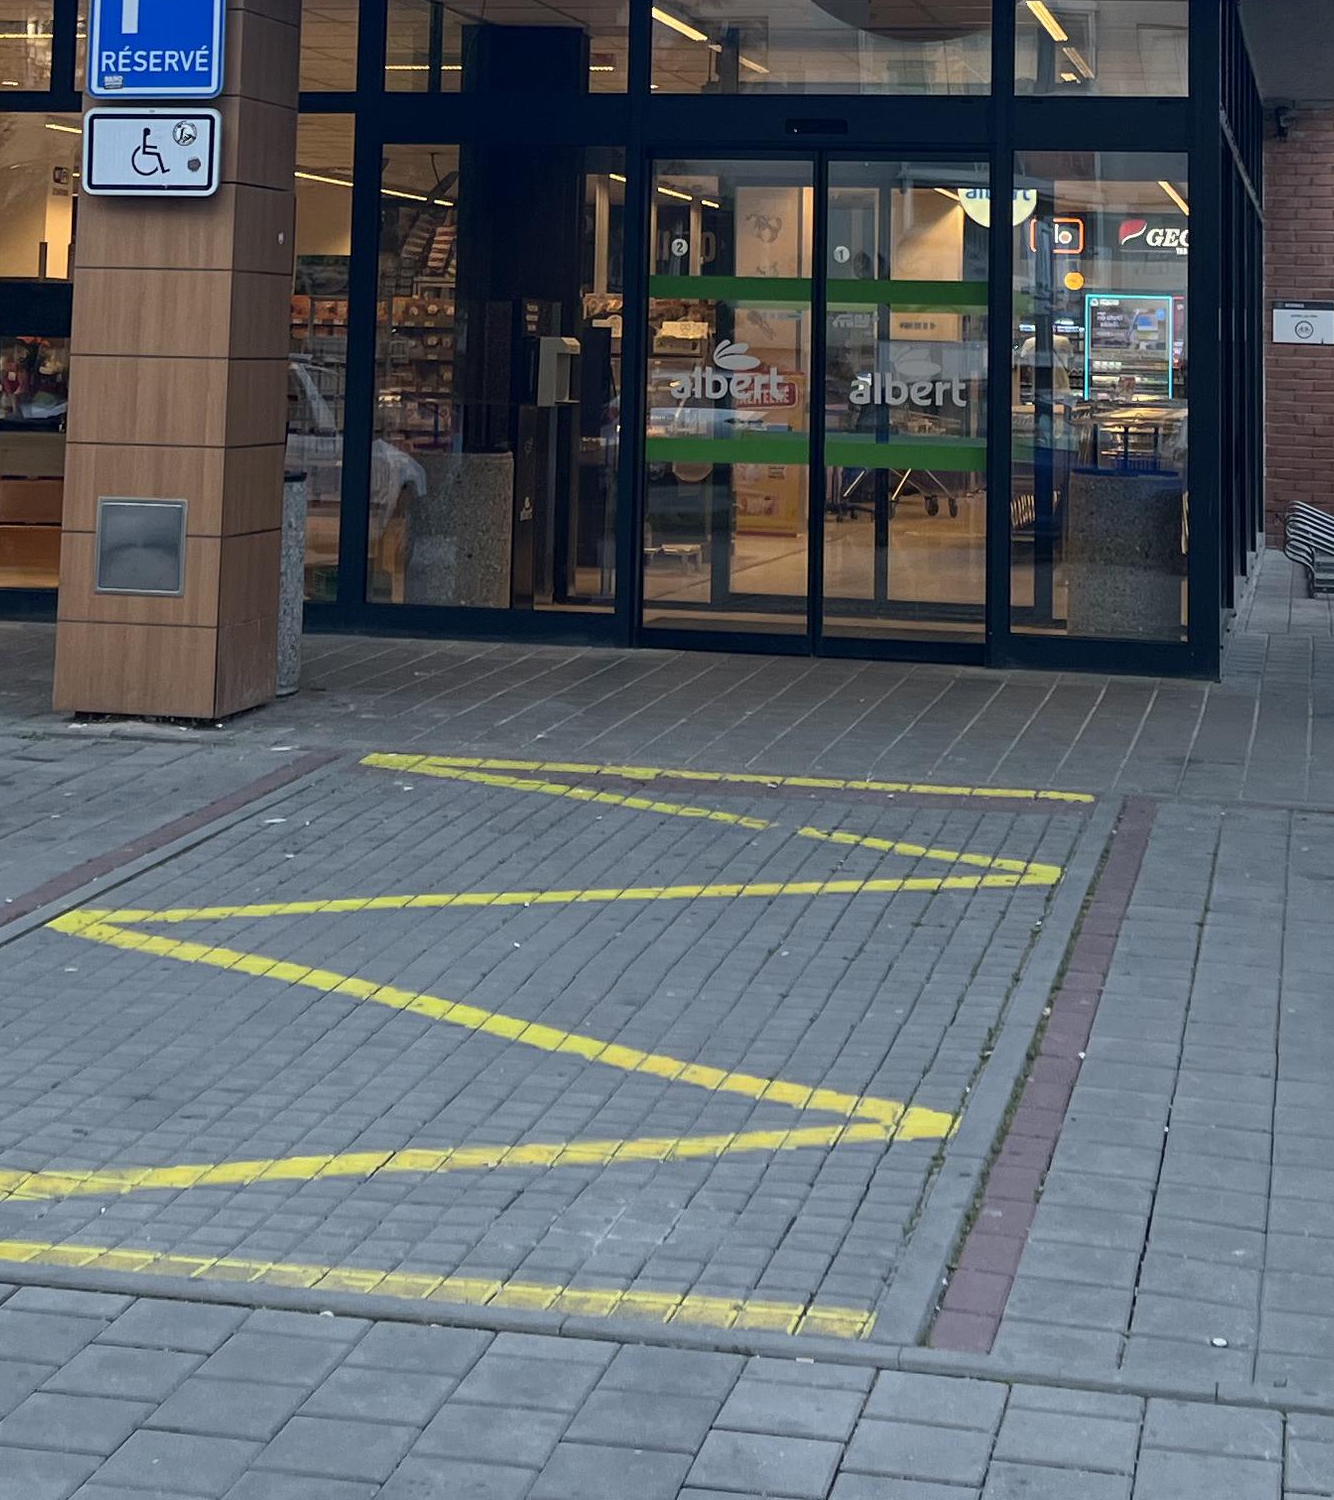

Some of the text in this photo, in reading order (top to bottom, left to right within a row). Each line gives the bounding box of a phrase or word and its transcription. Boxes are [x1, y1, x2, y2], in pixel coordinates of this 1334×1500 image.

[101, 45, 210, 73] RÉSERVÉ
[670, 365, 785, 401] albert
[849, 372, 967, 408] albert
